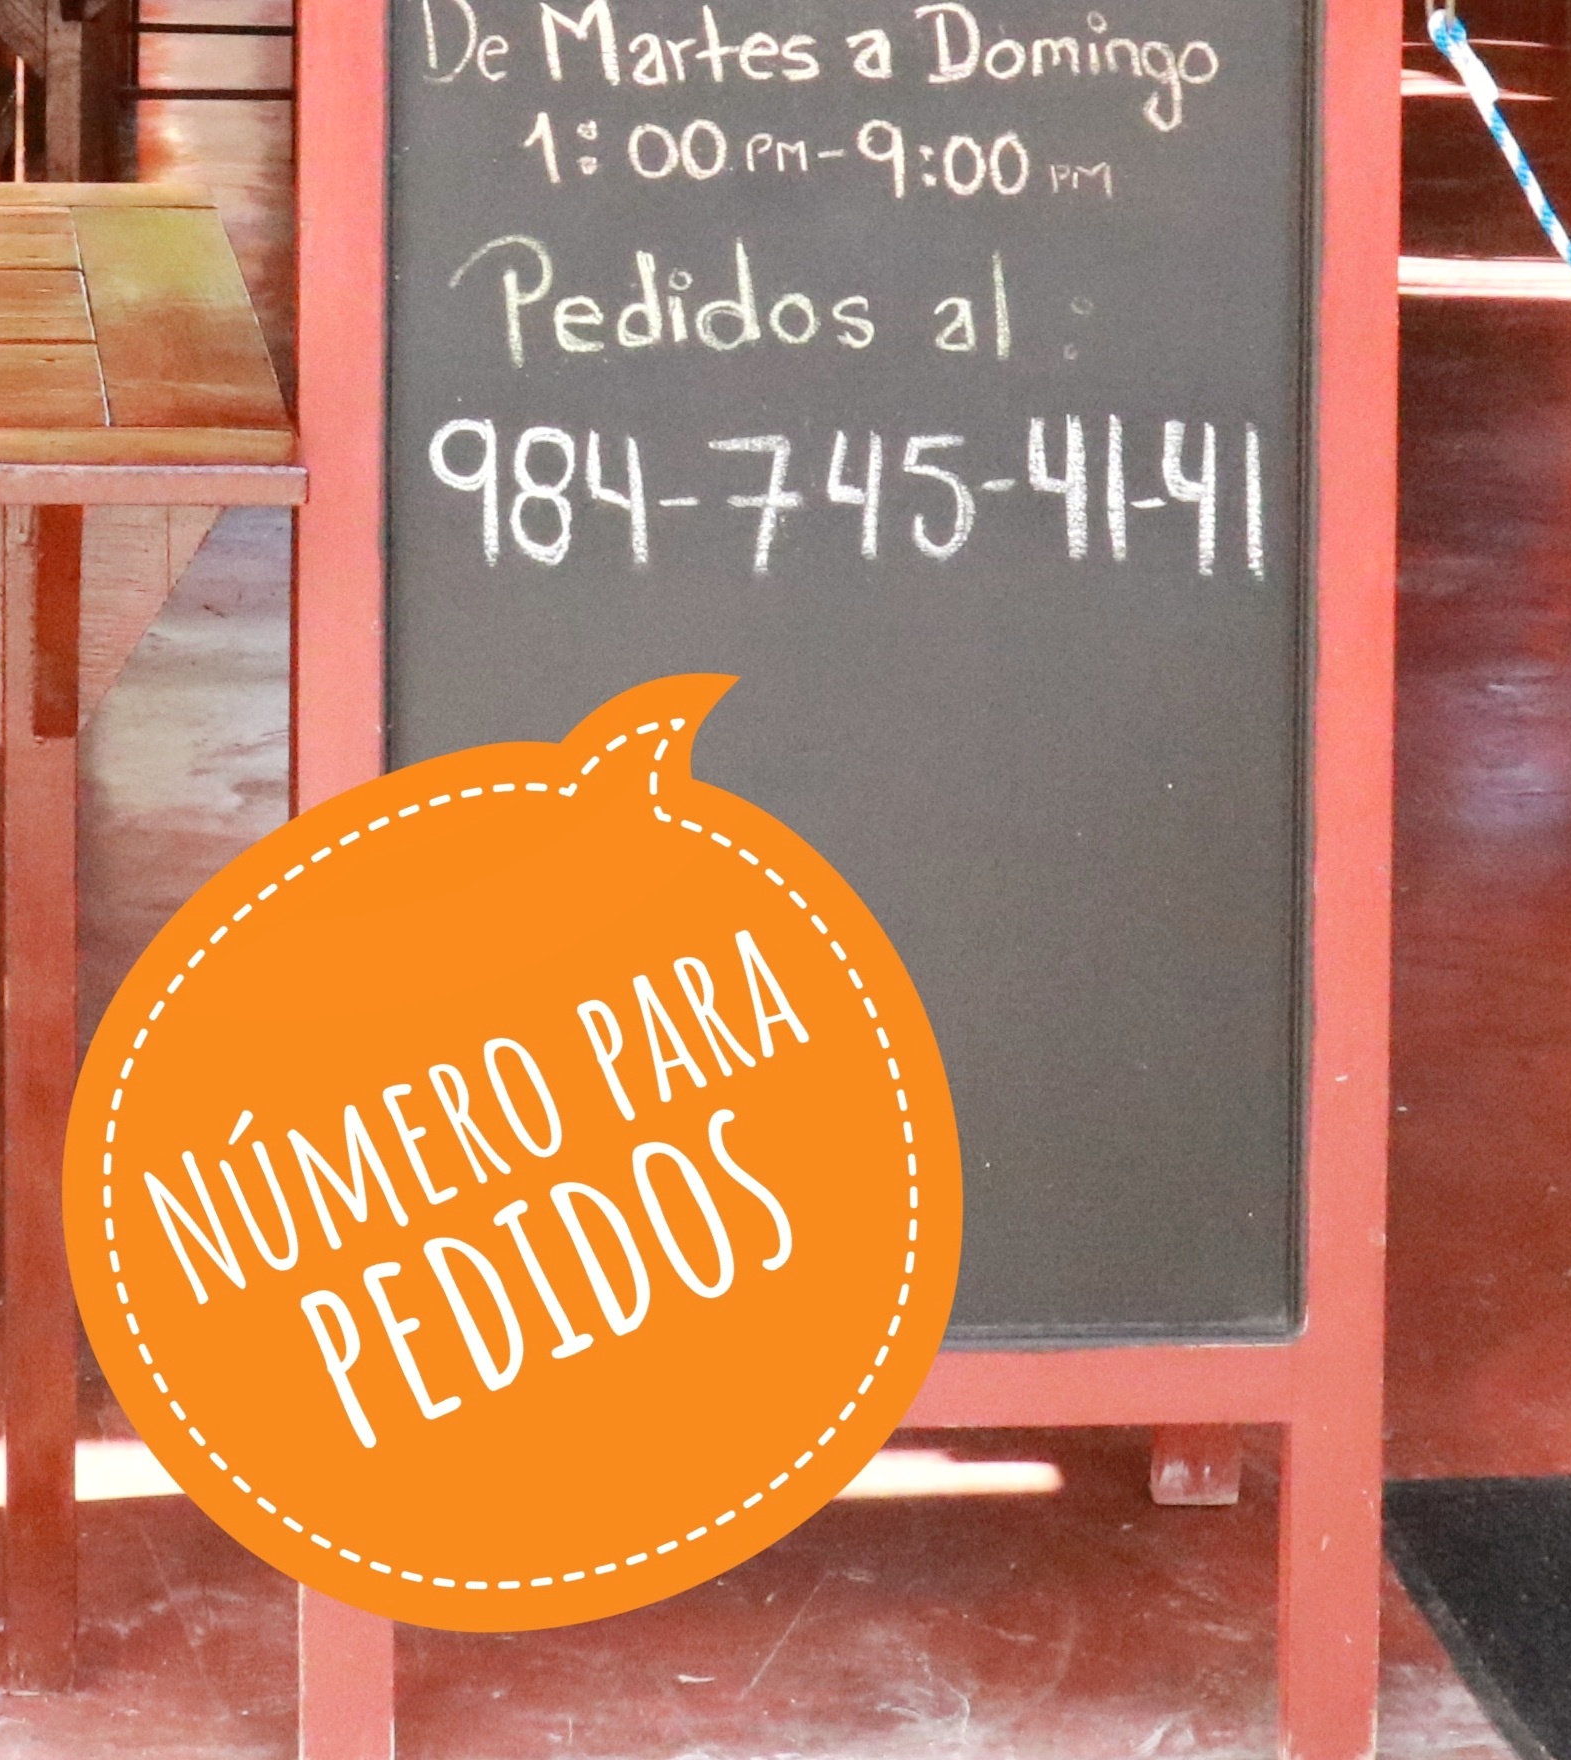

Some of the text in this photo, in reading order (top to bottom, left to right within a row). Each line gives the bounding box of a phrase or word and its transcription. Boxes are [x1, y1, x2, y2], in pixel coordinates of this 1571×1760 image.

[846, 28, 893, 79] a
[912, 1, 1220, 133] Domingo
[1049, 160, 1114, 199] PM
[448, 235, 876, 369] Pedidos
[932, 250, 1012, 362] al
